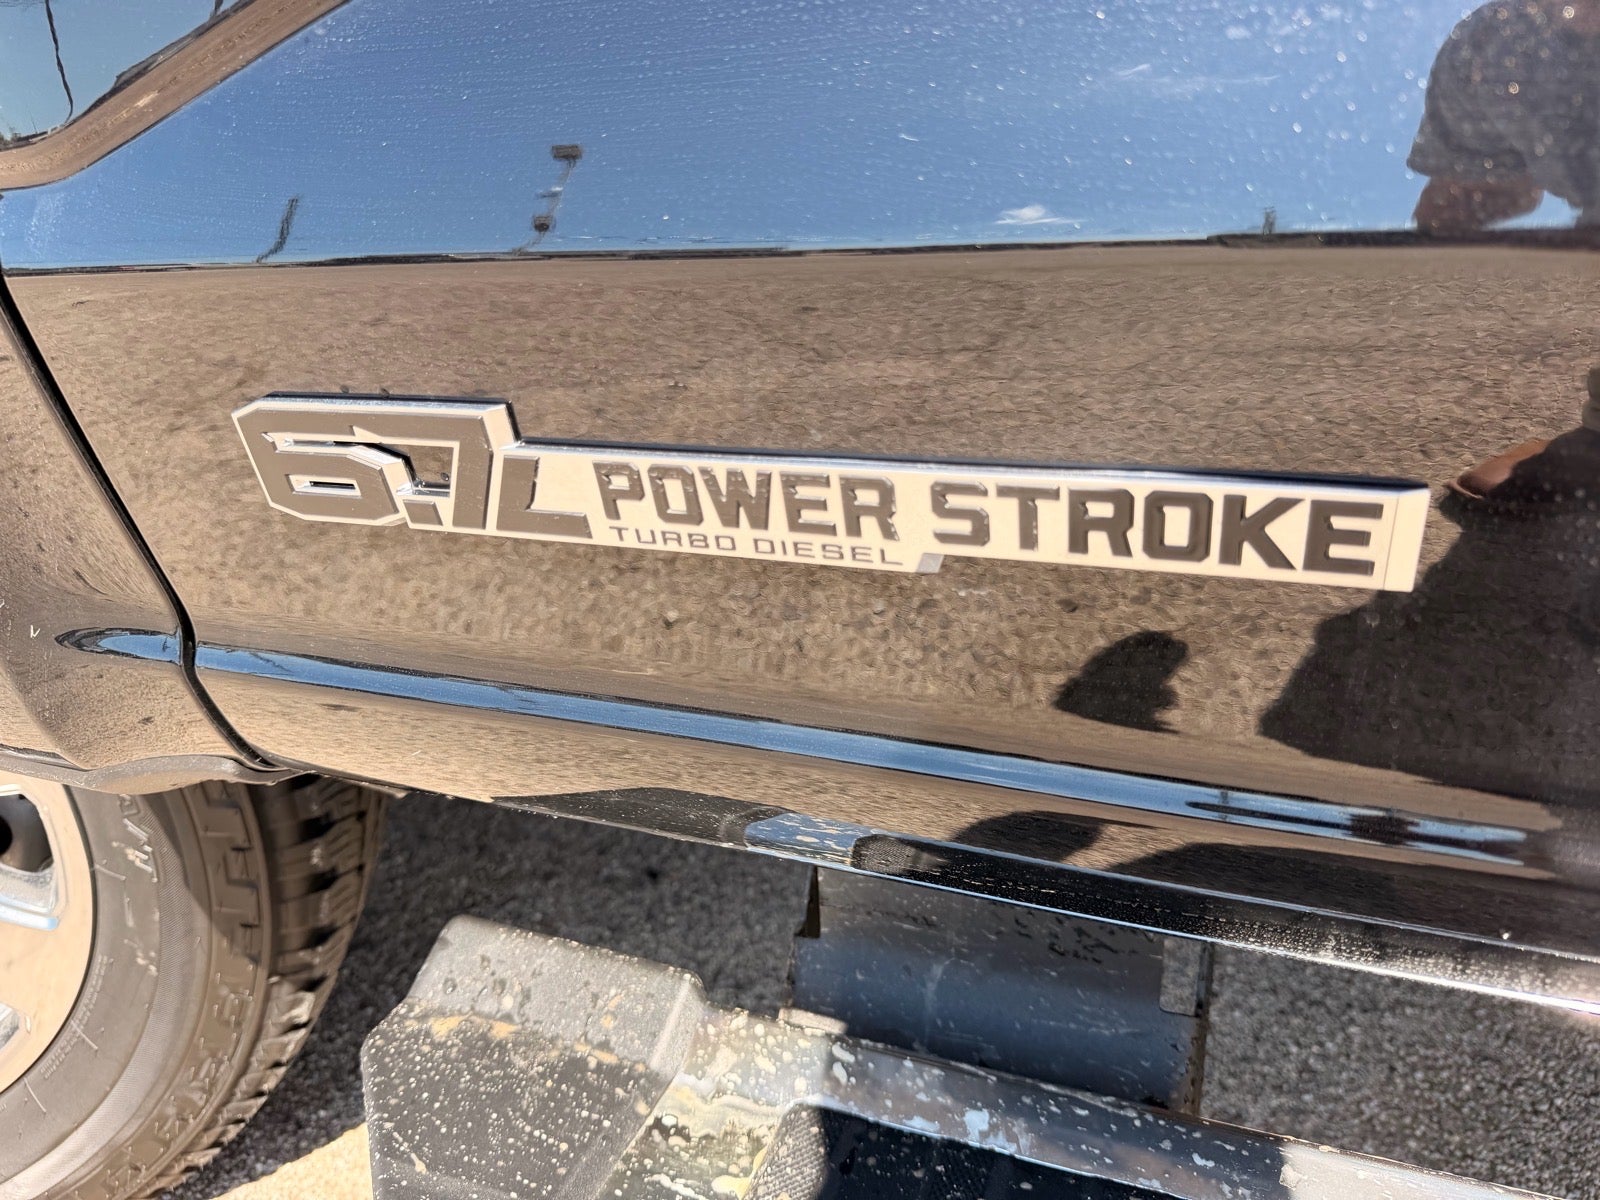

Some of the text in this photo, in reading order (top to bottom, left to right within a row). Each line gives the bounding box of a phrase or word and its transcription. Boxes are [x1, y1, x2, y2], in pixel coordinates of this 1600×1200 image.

[235, 405, 1384, 576] 6.7L POWER STROKE
[608, 525, 904, 566] TURBO DIESEL
